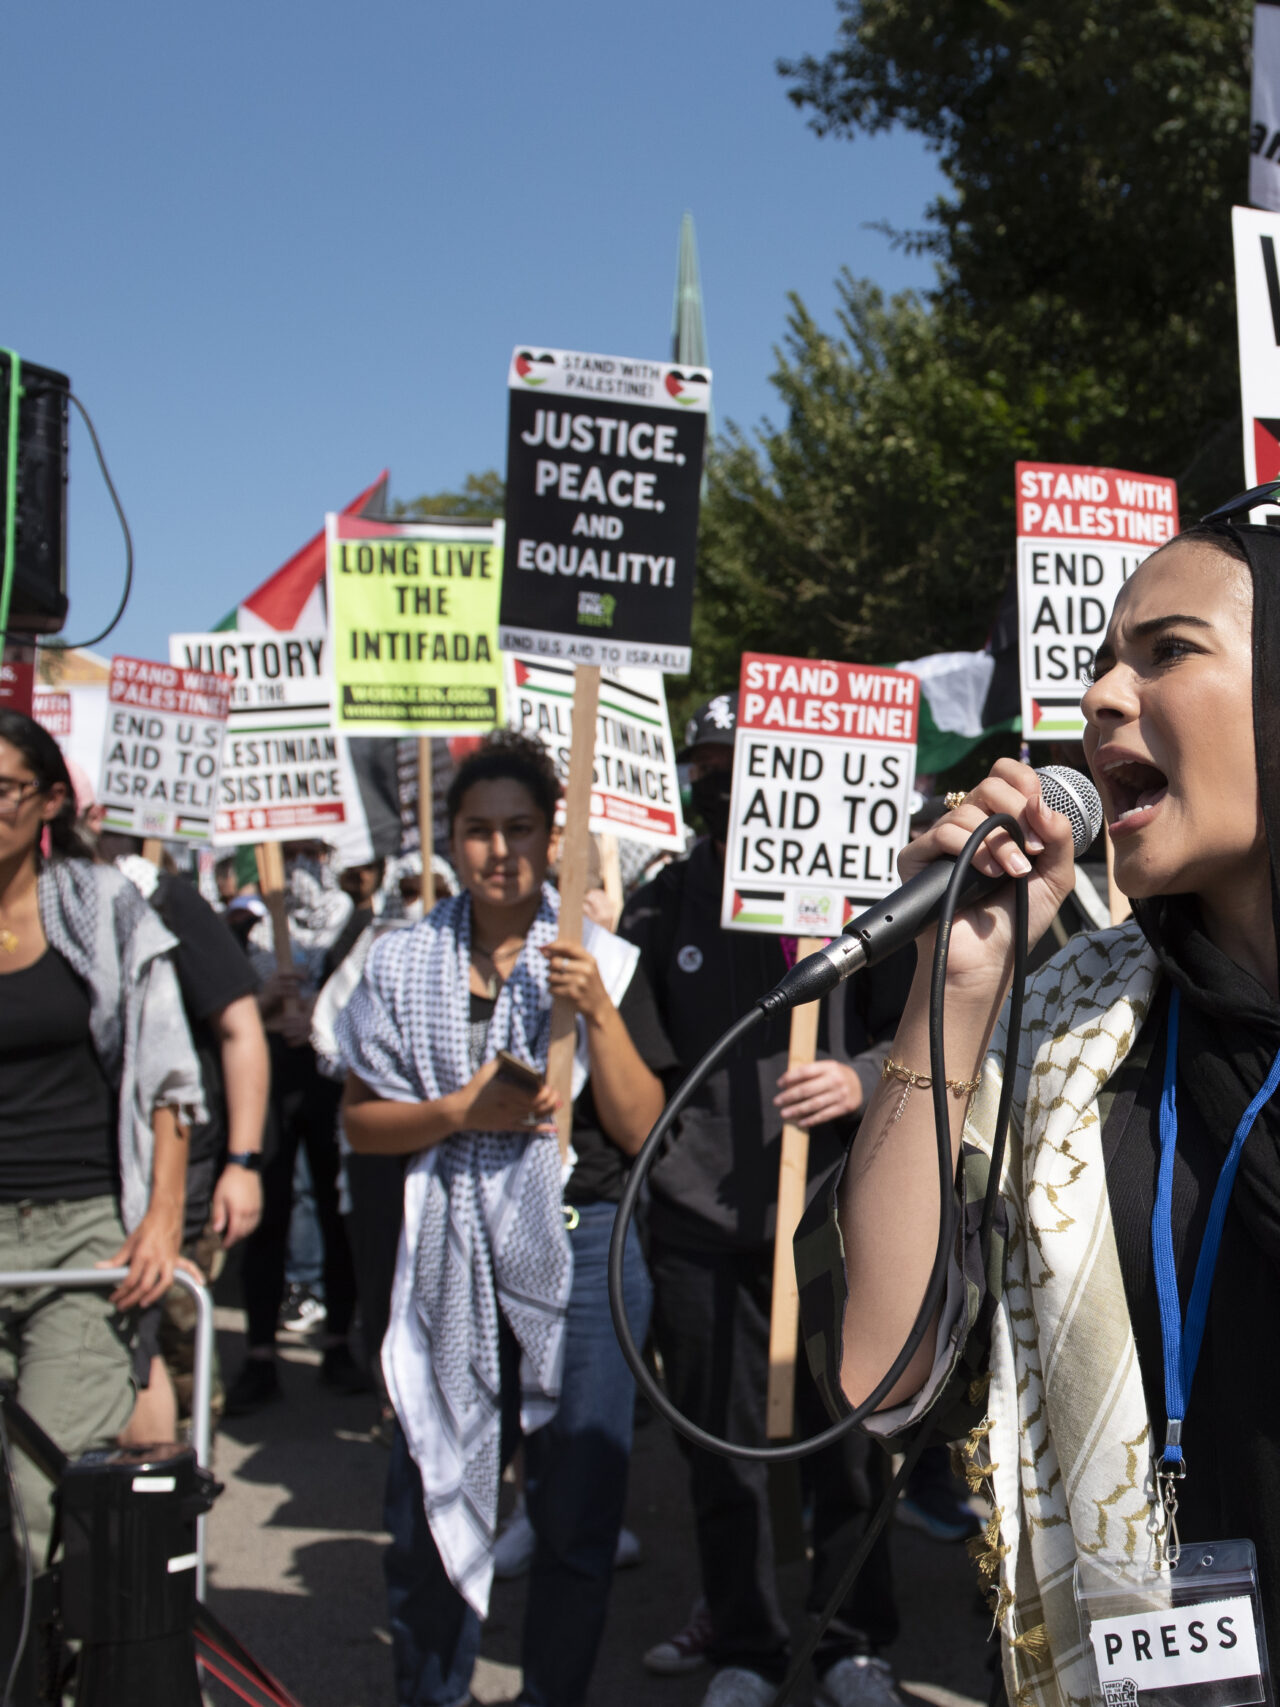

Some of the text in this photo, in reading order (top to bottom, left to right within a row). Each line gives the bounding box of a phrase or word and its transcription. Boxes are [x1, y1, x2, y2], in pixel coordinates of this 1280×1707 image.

[563, 354, 660, 380] STAND WITH
[566, 374, 654, 399] PALESTINE!
[521, 409, 686, 467] JUSTICE.
[535, 459, 666, 513] PEACE.
[1021, 471, 1172, 511] STAND WITH
[572, 513, 624, 540] AND
[1023, 503, 1175, 543] PALESTINE!
[340, 545, 491, 579] LONG LIVE
[517, 538, 676, 588] EQUALITY!
[1032, 552, 1104, 586] END
[395, 586, 447, 615] THE
[1032, 596, 1106, 634] AID
[185, 639, 323, 680] VICTORY
[351, 631, 491, 663] INTIFADA
[504, 633, 533, 650] END
[567, 643, 594, 659] AID
[601, 647, 622, 661] TO
[626, 649, 686, 670] ISRAEL!
[114, 659, 180, 688] STAND
[745, 661, 915, 706] STAND WITH
[112, 711, 164, 741] END
[744, 693, 912, 740] PALESTINE!
[107, 742, 216, 779] AID TO
[222, 736, 338, 768] ESTINIAN
[748, 744, 900, 789] END U.S
[105, 771, 213, 807] ISRAEL!
[219, 769, 341, 804] SISTANCE
[742, 788, 898, 837] AID TO
[740, 836, 895, 883] ISRAEL!
[1104, 1616, 1238, 1665] PRESS
